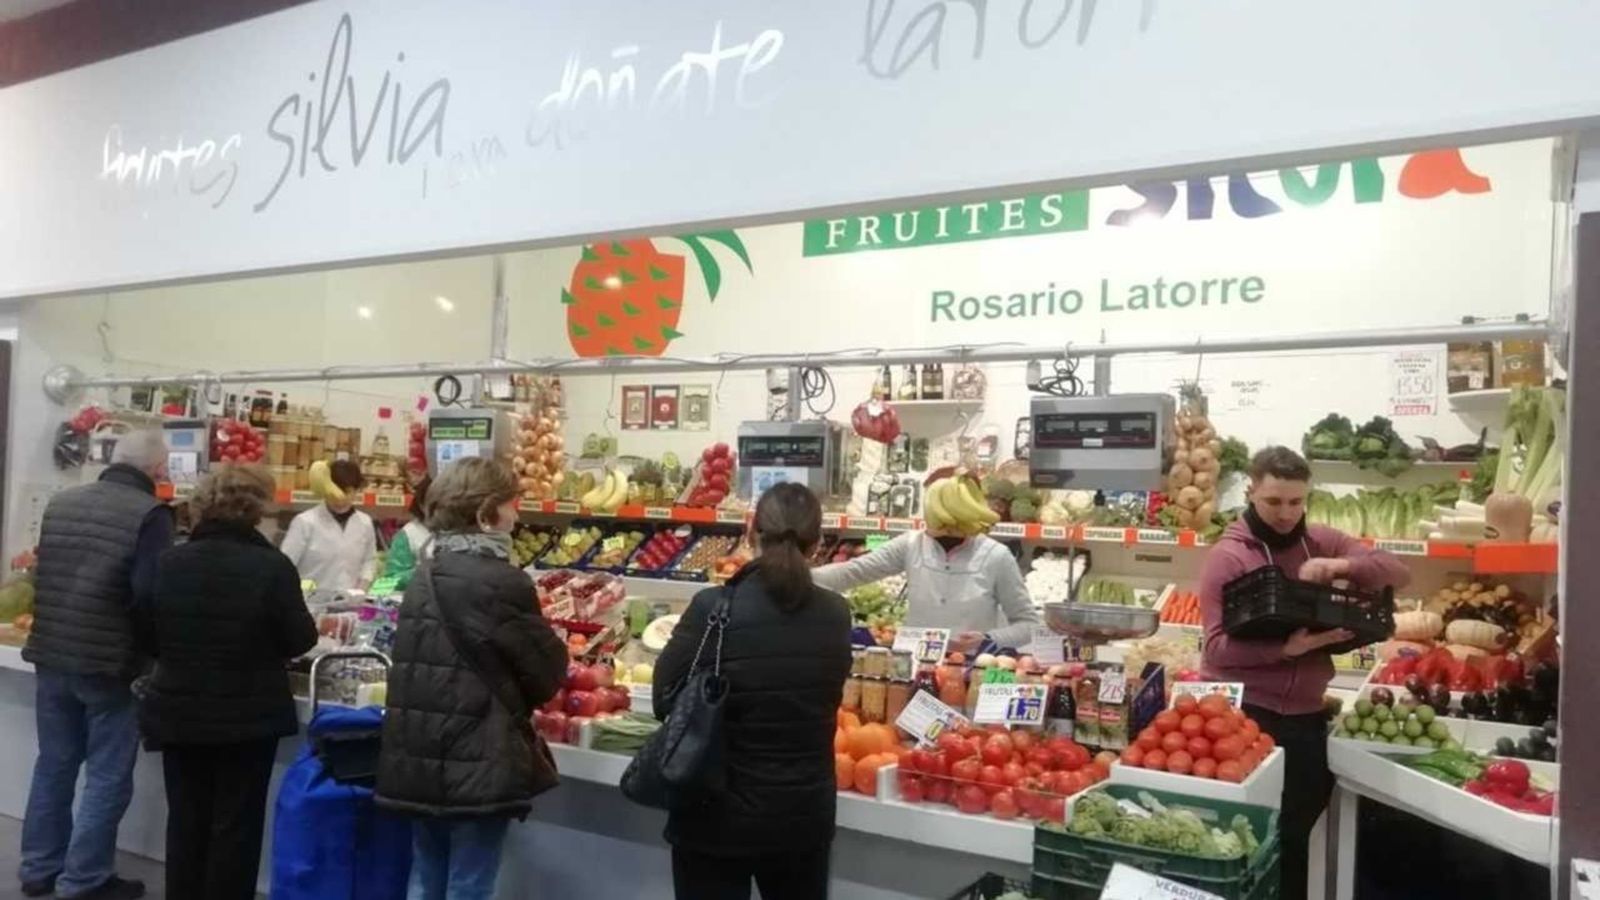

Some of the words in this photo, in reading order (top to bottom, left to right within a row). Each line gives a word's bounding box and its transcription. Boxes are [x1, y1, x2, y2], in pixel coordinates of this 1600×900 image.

[253, 12, 451, 214] silvia
[824, 194, 1063, 249] FRUITES
[930, 283, 1083, 322] Rosario
[1099, 275, 1266, 313] Latorre
